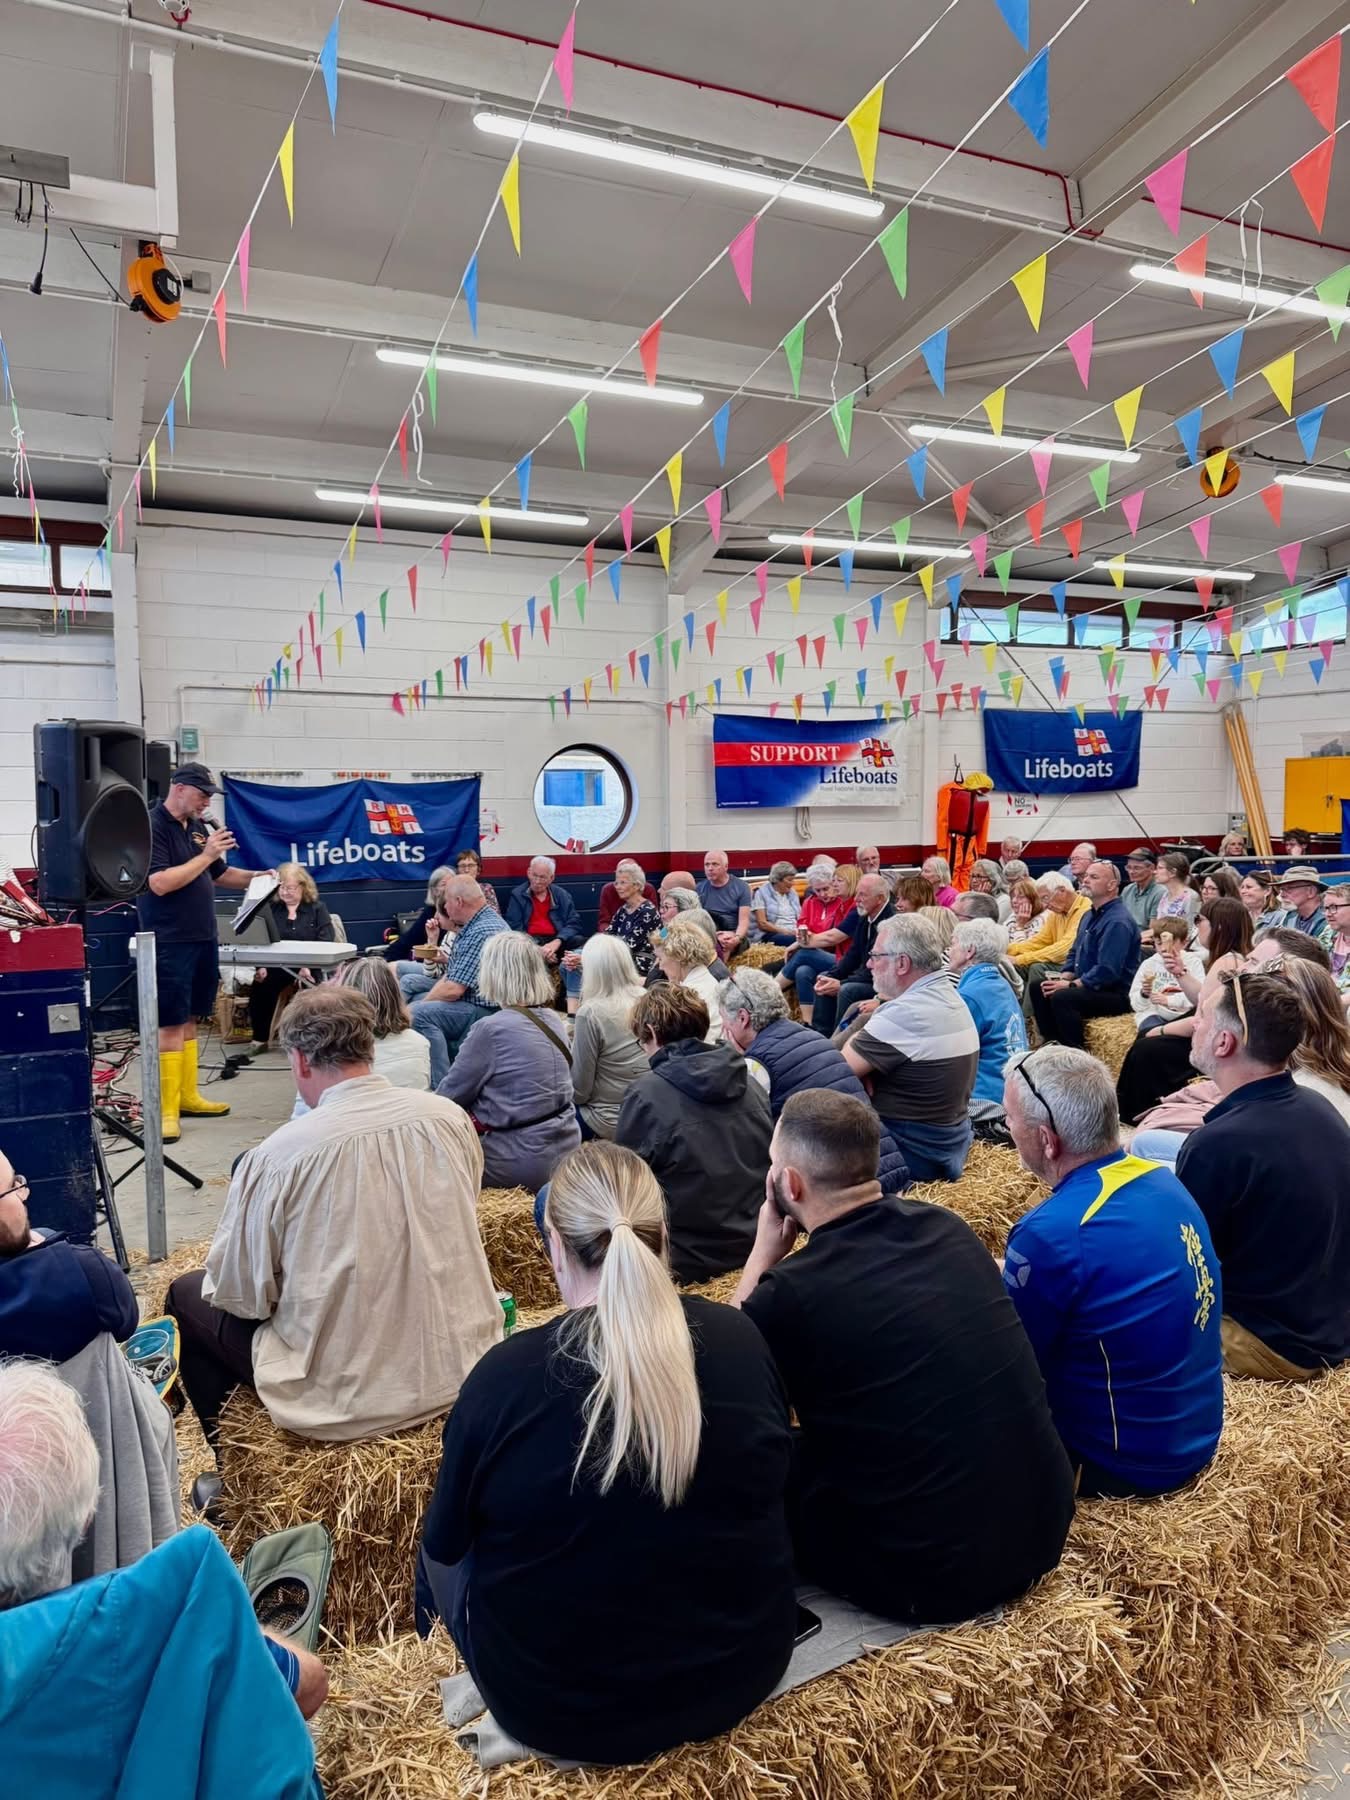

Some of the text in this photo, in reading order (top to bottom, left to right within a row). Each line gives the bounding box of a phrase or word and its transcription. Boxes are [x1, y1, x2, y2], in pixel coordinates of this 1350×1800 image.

[750, 745, 840, 762] SUPPORT
[820, 766, 897, 784] Lifeboats
[1025, 757, 1113, 778] Lifeboats
[291, 838, 425, 867] Lifeboats
